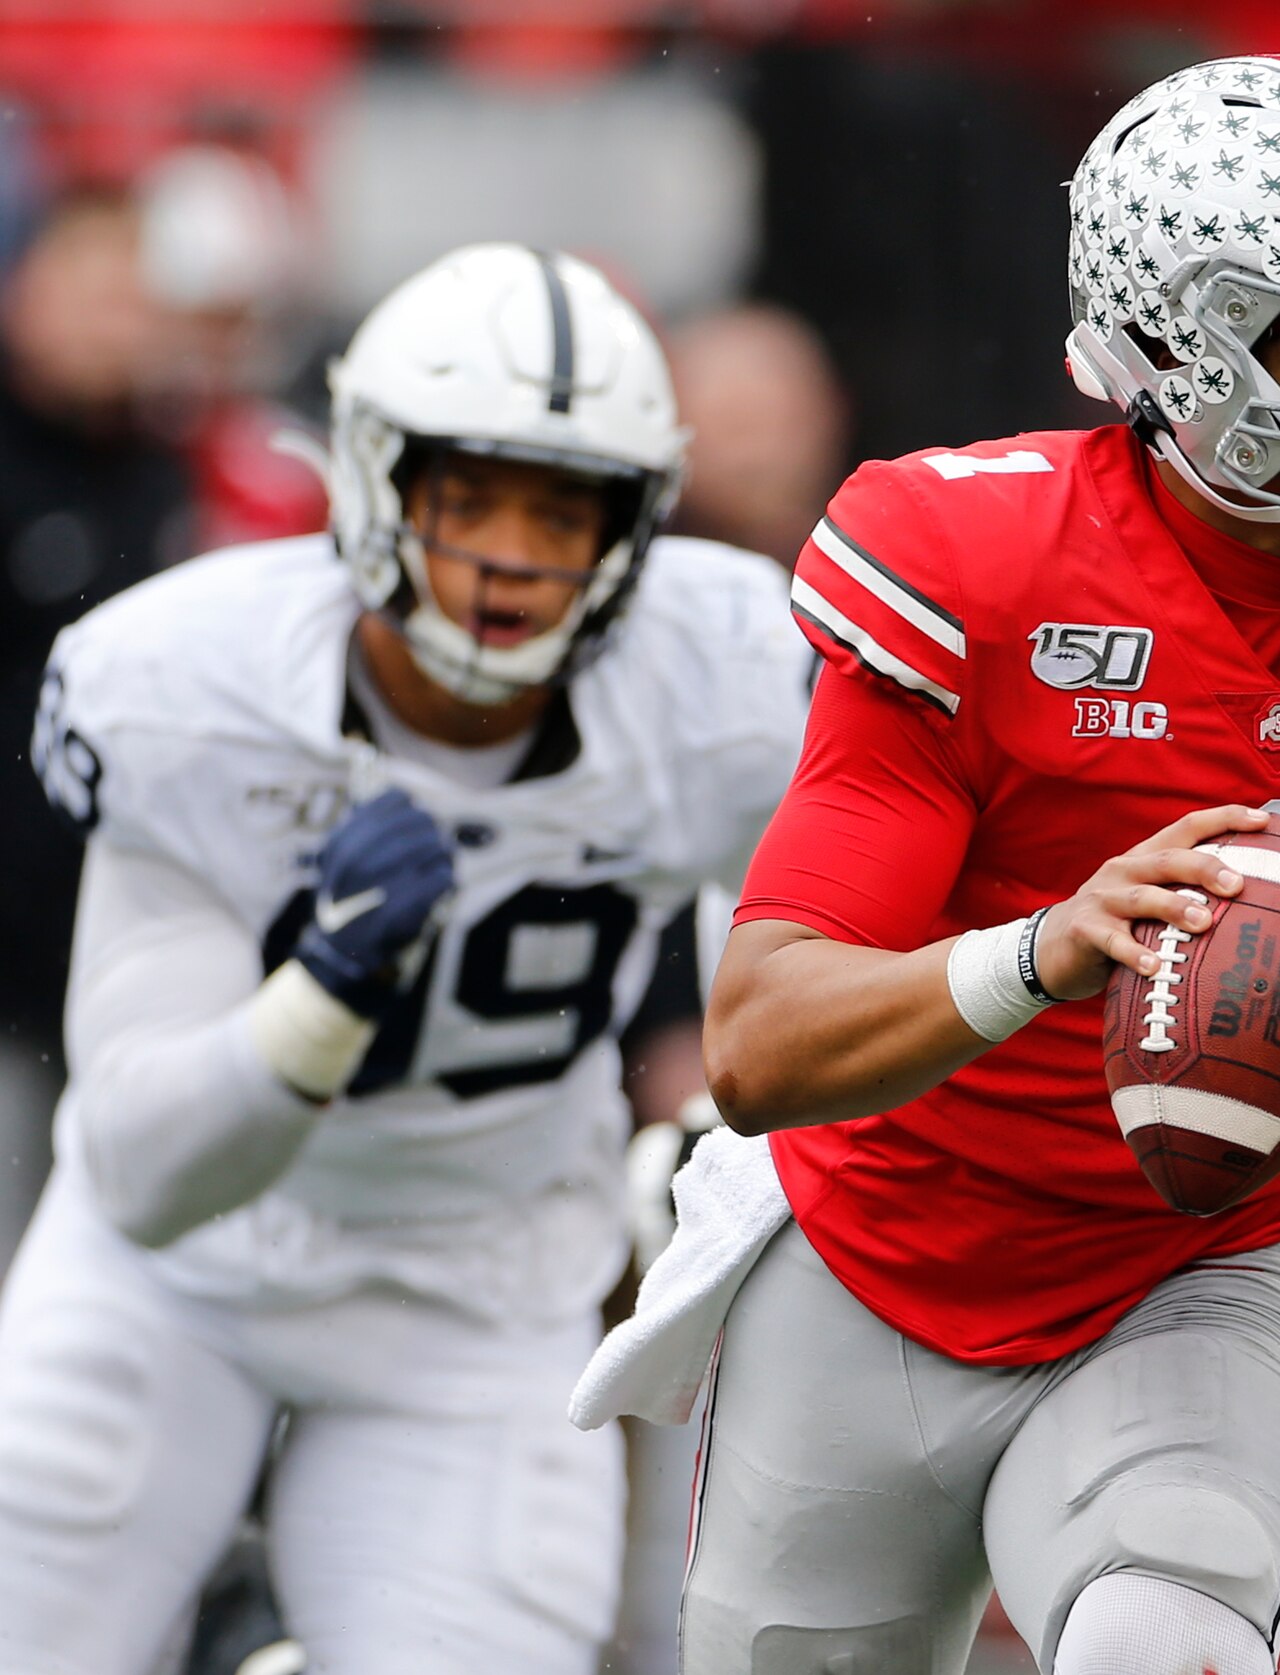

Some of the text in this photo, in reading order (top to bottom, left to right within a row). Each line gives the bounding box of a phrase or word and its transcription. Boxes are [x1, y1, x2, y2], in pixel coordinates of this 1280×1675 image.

[1029, 623, 1153, 691] 150
[1018, 927, 1035, 982] HUMBLE
[1208, 918, 1263, 1038] Wilson
